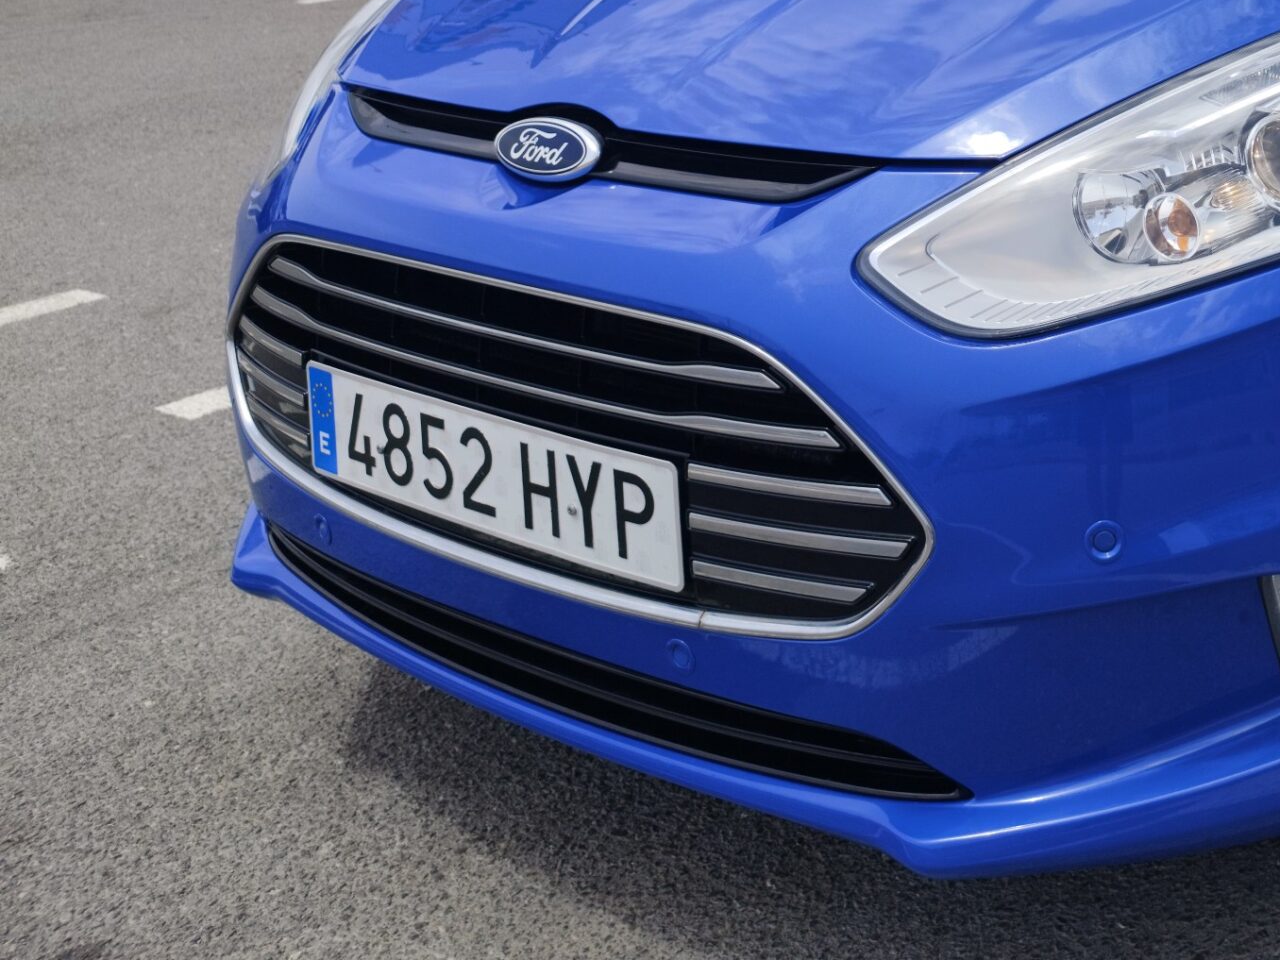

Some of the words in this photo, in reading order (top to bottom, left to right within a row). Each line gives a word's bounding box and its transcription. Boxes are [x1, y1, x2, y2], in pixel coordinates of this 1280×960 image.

[510, 128, 568, 165] Ford
[319, 430, 331, 455] E
[348, 393, 497, 518] 4852
[520, 441, 655, 560] HYP
